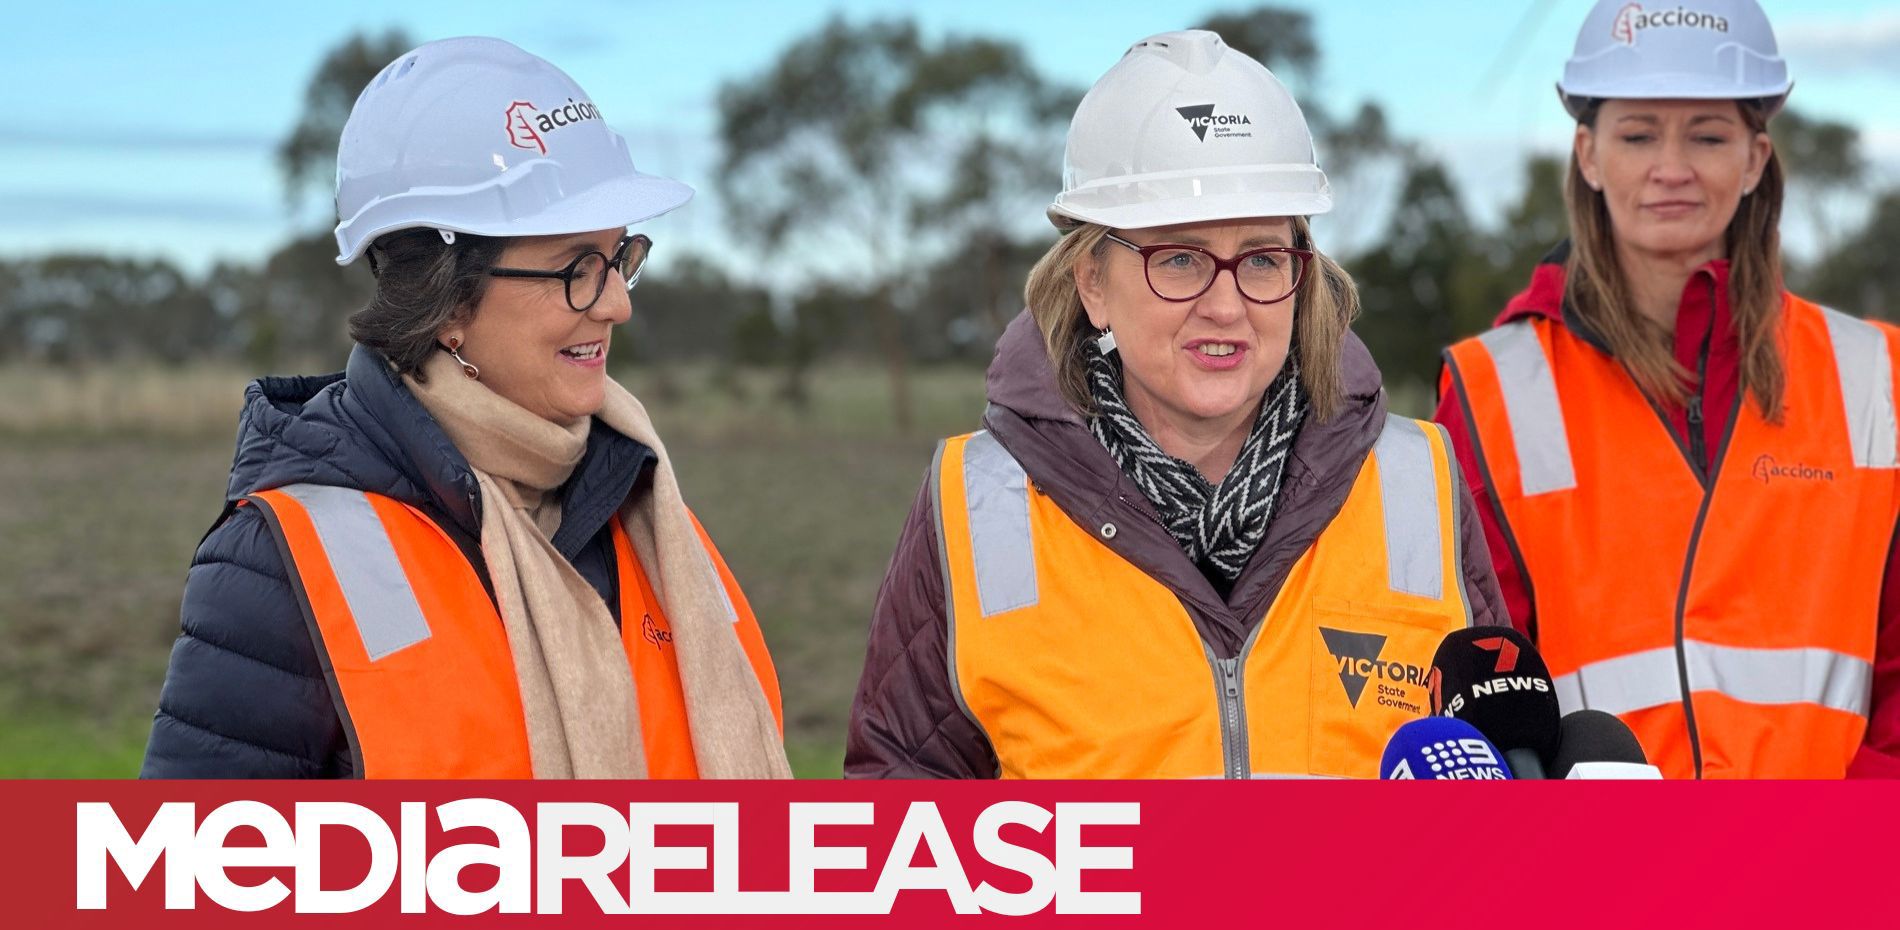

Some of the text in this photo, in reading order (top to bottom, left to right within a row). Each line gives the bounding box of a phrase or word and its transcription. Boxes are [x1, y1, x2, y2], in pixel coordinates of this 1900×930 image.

[1634, 5, 1728, 33] acciona
[536, 97, 603, 133] accion
[1184, 115, 1252, 127] VICTORIA
[1770, 463, 1833, 480] acciona
[1377, 684, 1406, 698] State
[1471, 677, 1549, 699] NEWS
